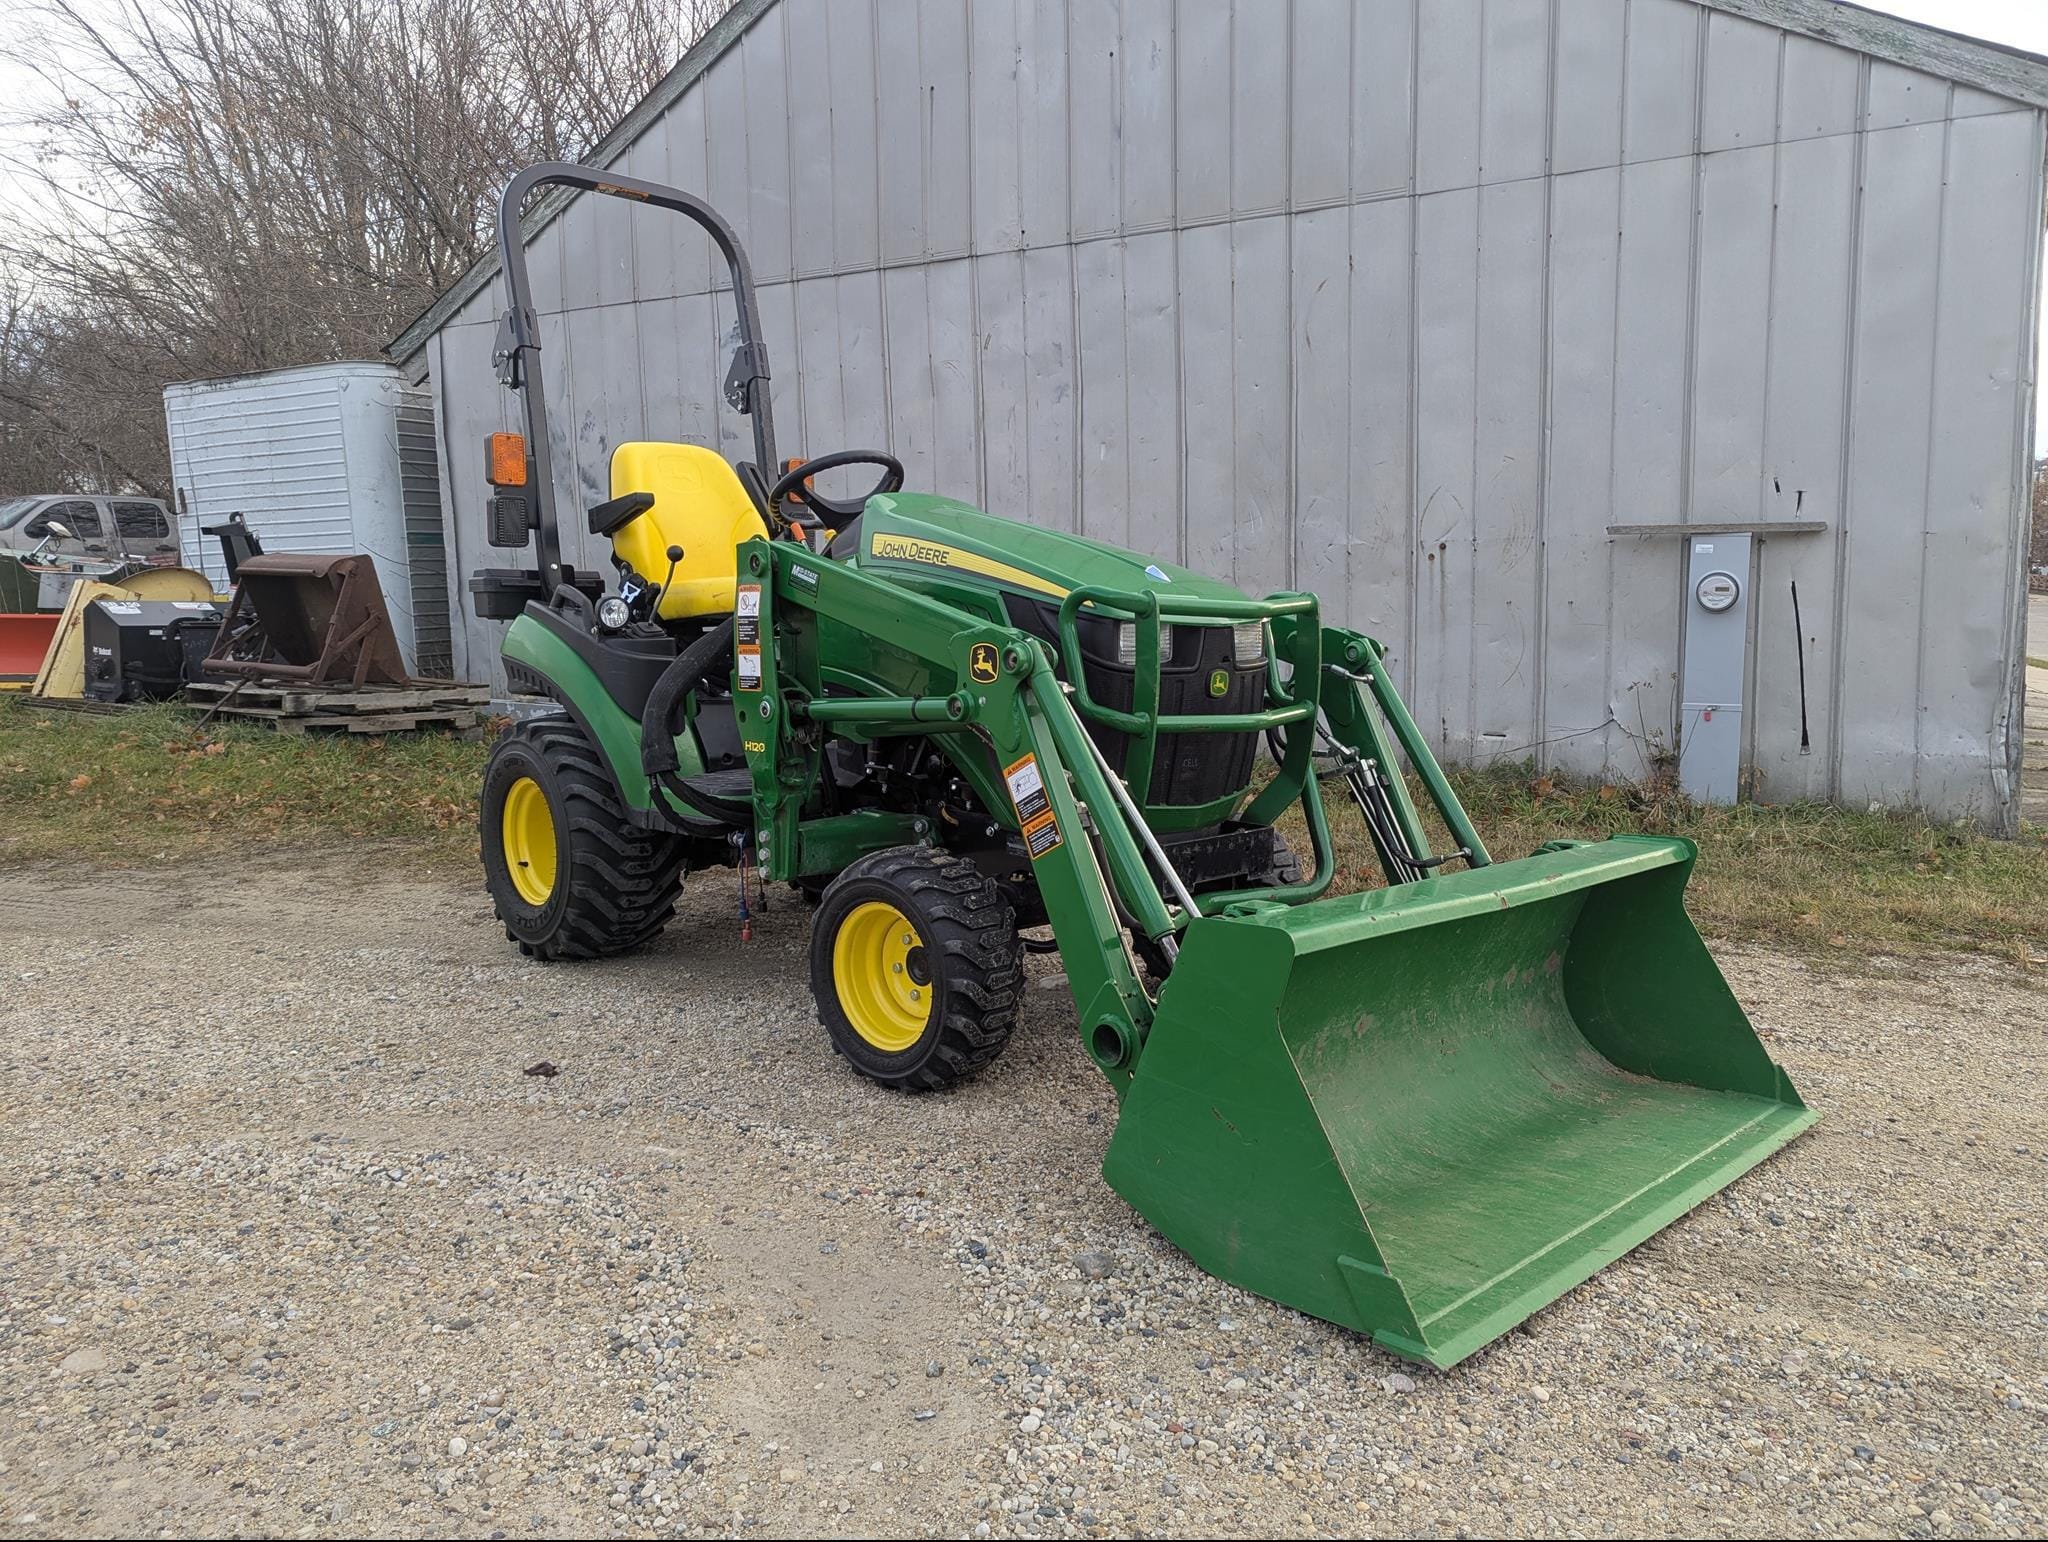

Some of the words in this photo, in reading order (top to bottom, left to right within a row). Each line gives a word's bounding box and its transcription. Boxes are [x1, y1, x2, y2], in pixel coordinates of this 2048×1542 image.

[878, 540, 908, 557] JOHN
[909, 543, 950, 564] DEERE
[744, 740, 766, 752] H120
